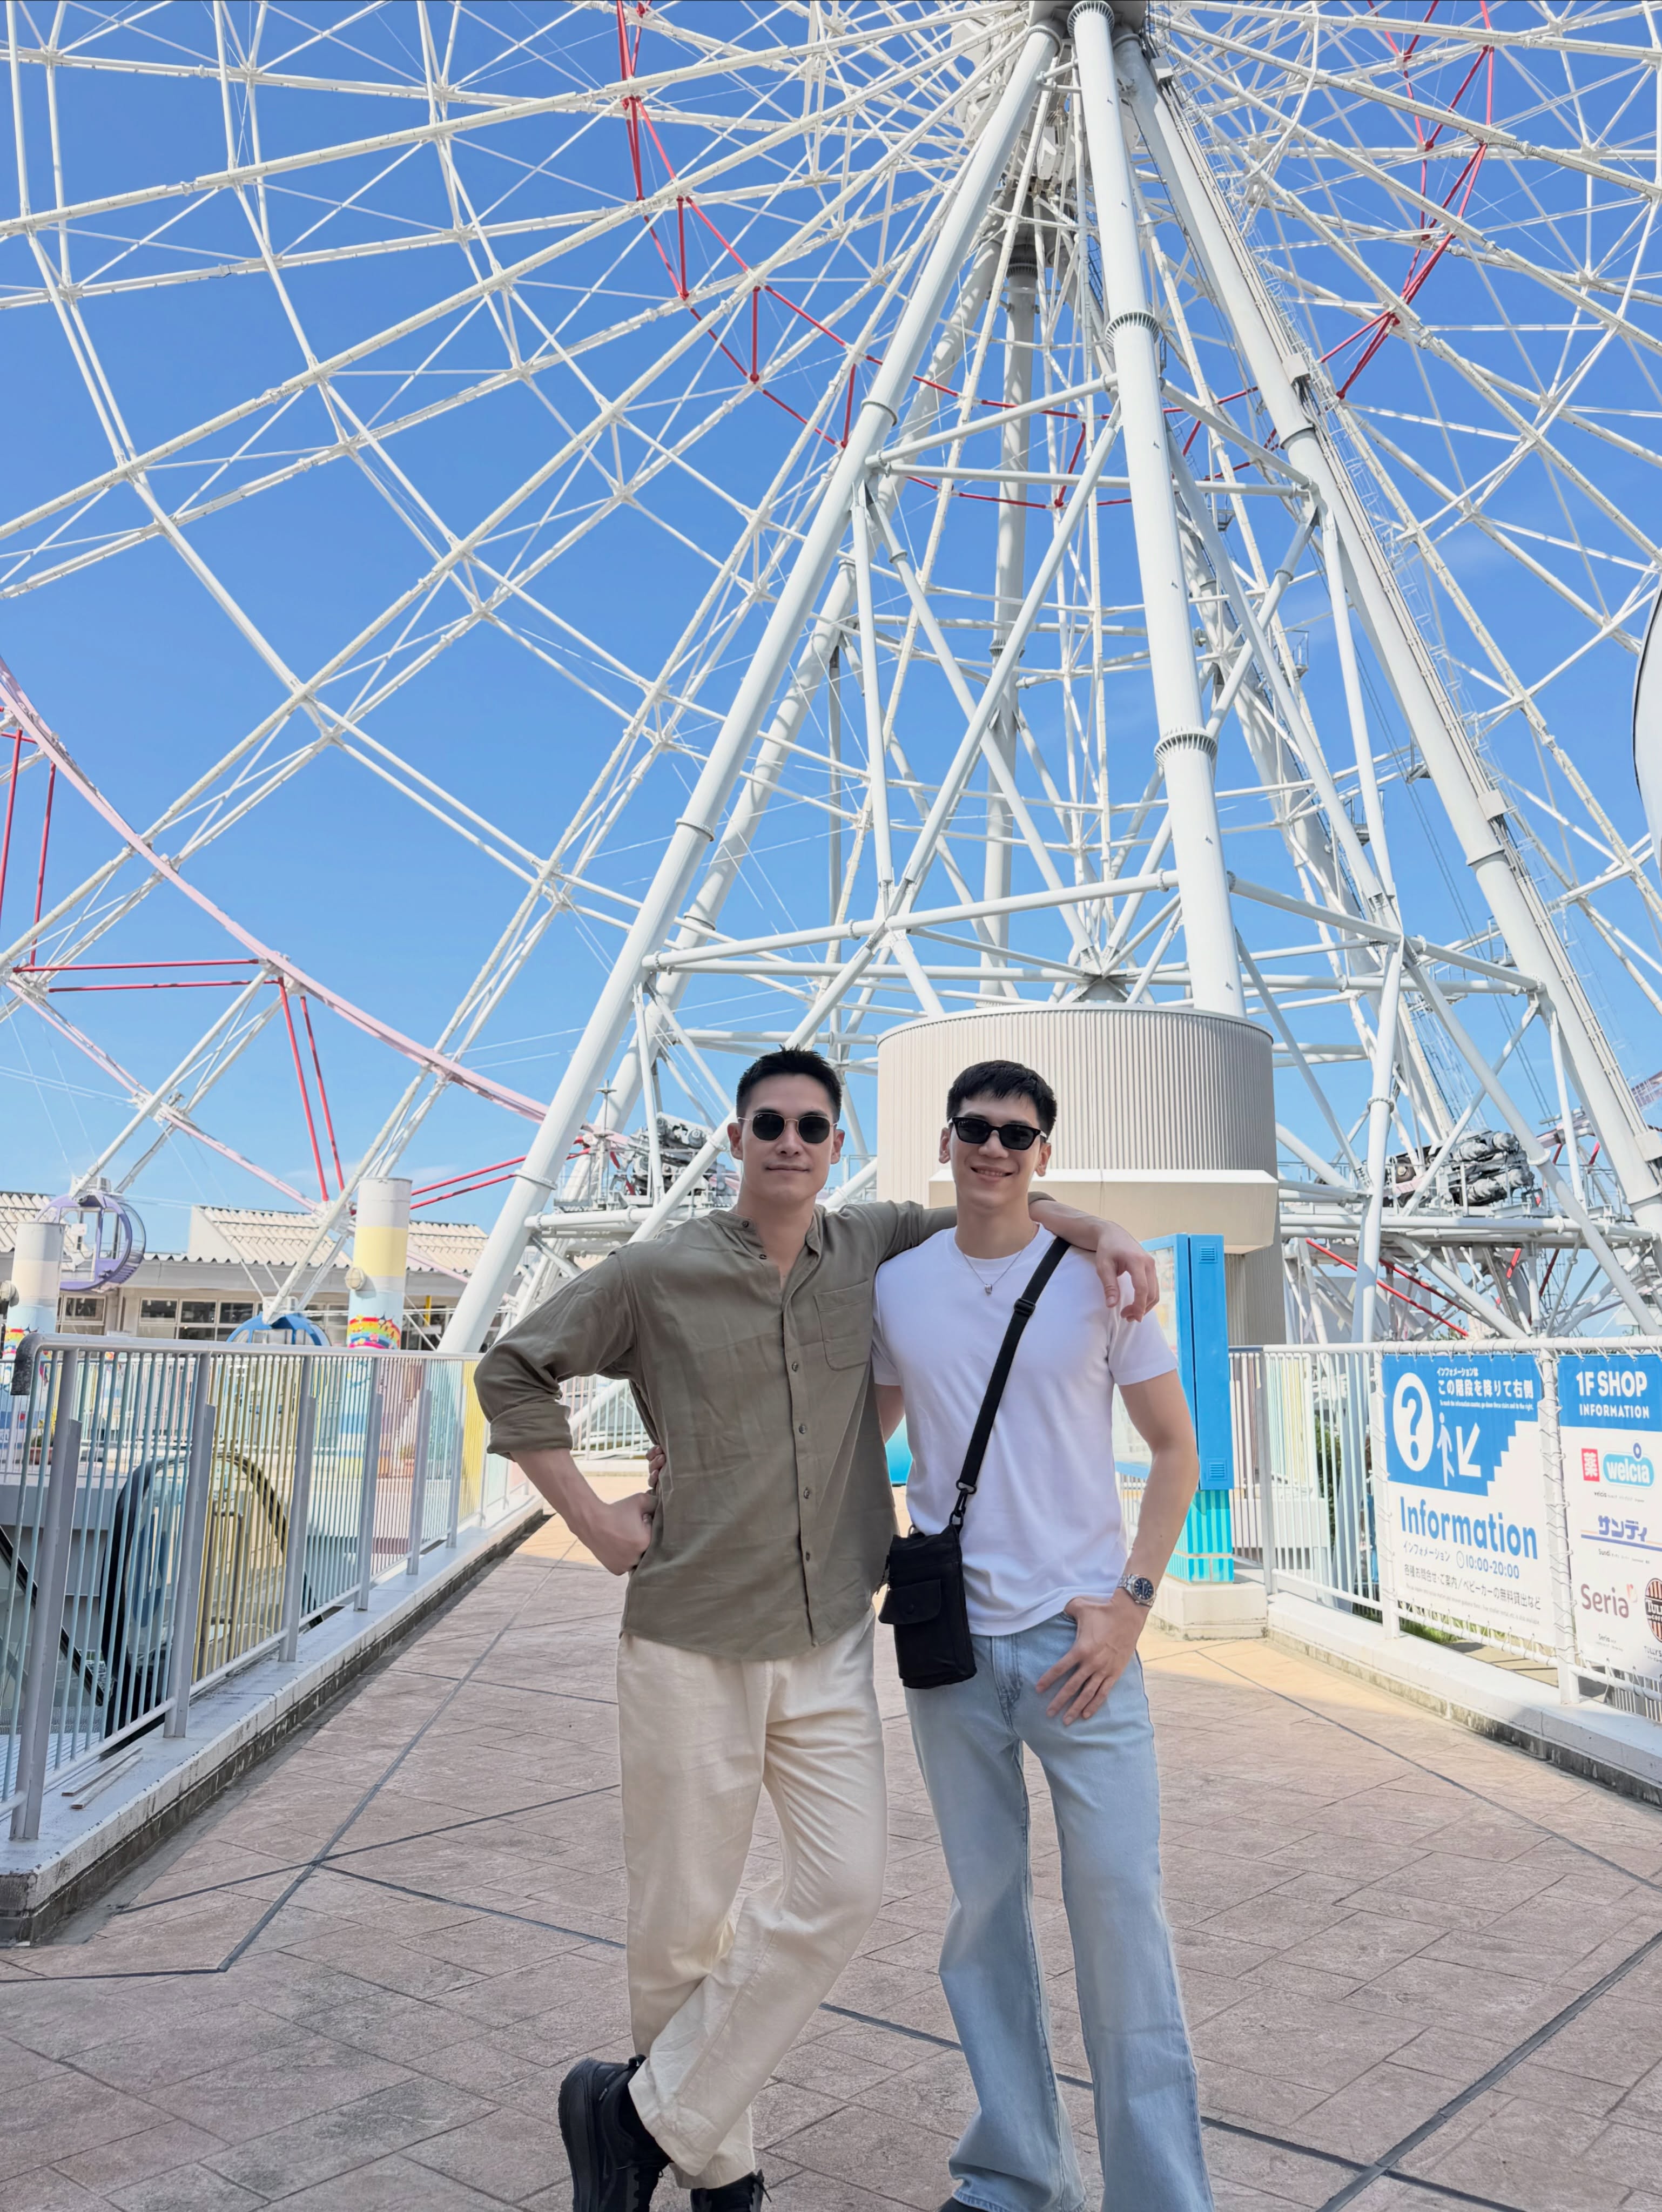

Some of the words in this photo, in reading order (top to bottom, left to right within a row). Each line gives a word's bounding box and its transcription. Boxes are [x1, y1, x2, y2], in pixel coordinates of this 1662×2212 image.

[1438, 1379, 1534, 1399] この階段を降りて右側
[1576, 1371, 1594, 1397] 1F
[1597, 1371, 1647, 1397] SHOP
[1579, 1404, 1650, 1419] INFORMATION
[1606, 1447, 1650, 1484] welcia
[1400, 1495, 1538, 1560] Information
[1598, 1515, 1647, 1542] サンディ
[1403, 1540, 1451, 1562] インフォメーション
[1580, 1583, 1630, 1619] Seria
